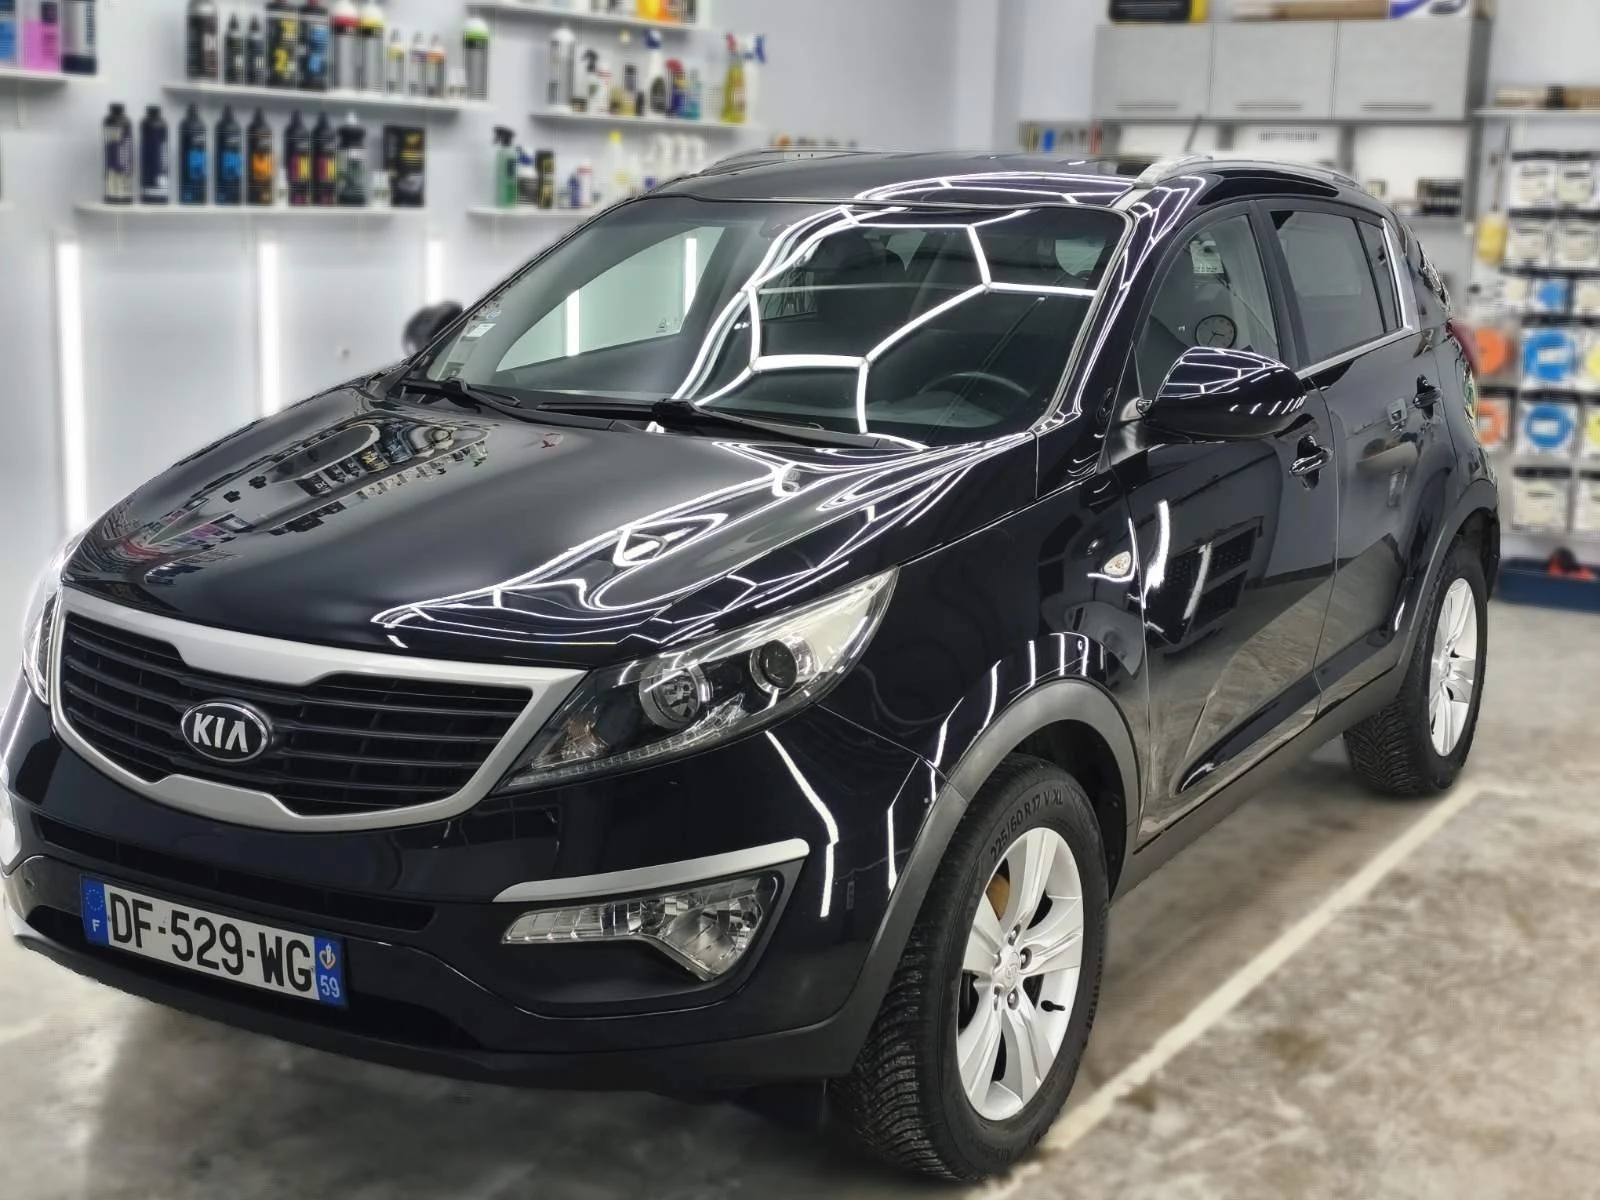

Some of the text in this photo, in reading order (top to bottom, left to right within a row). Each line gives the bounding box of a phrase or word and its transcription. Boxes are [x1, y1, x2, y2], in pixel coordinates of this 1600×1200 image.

[193, 712, 248, 753] KIA
[990, 808, 1024, 862] 225/60
[1052, 788, 1063, 806] XL
[91, 918, 101, 932] F
[109, 891, 313, 993] DF-529-WG
[319, 974, 341, 998] 59
